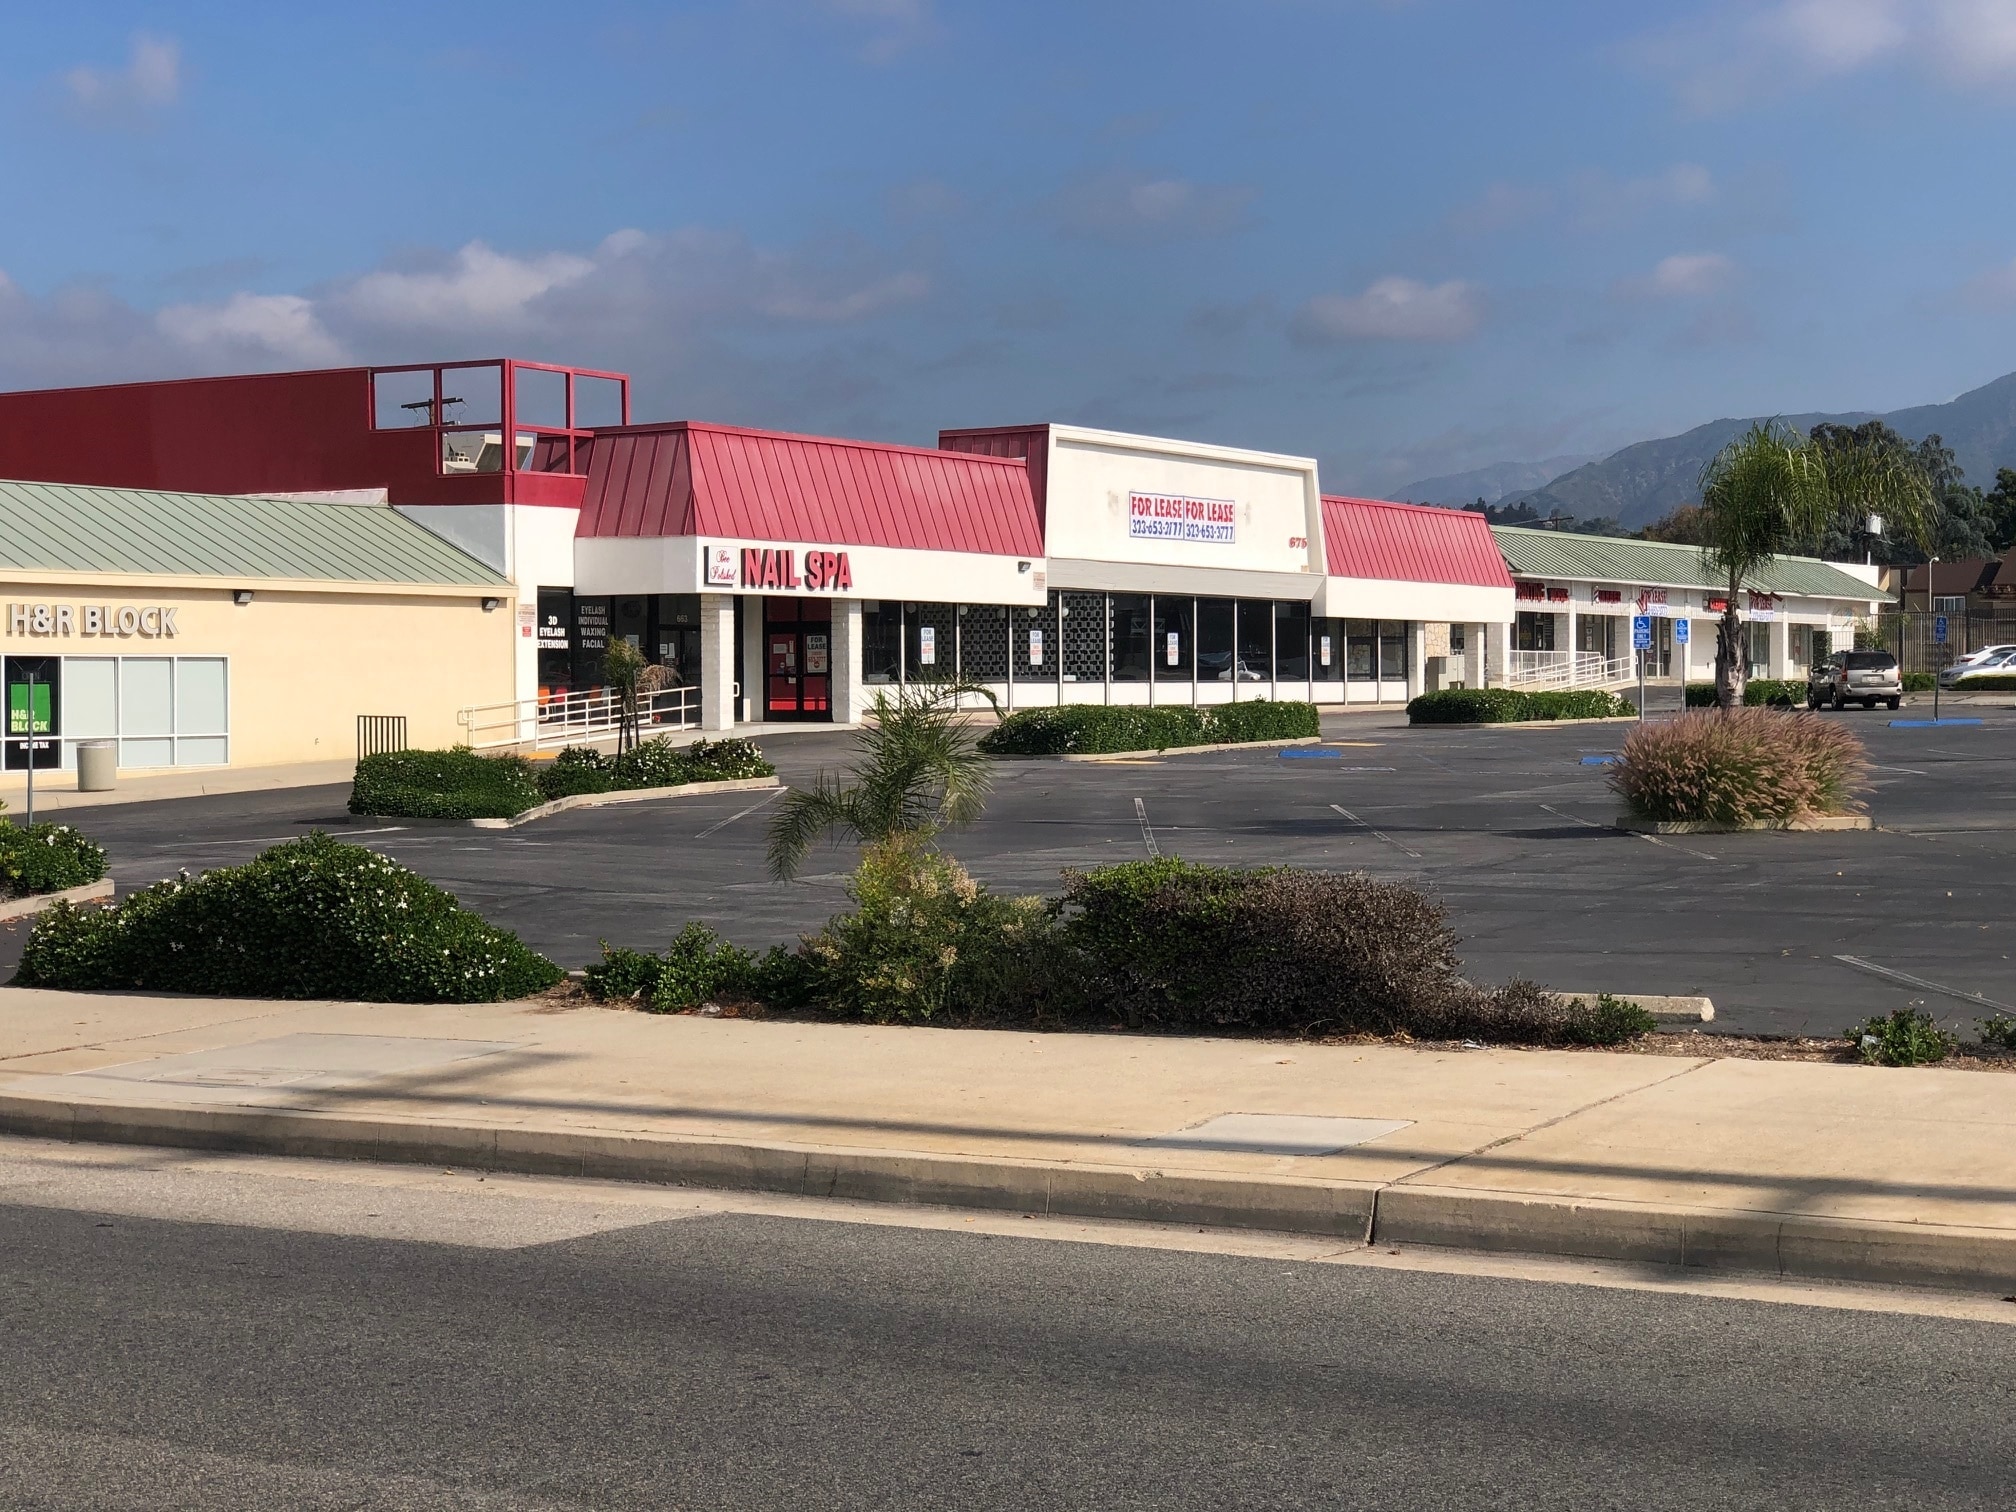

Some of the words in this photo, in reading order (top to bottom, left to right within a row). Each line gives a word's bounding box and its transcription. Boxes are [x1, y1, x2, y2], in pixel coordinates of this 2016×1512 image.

[1132, 496, 1152, 516] FOR
[1154, 498, 1182, 518] LEASE
[1186, 500, 1205, 520] FOR
[1207, 502, 1233, 523] LEASE
[1289, 537, 1307, 549] 675
[742, 548, 802, 588] NAIL
[806, 550, 853, 589] SPA
[581, 606, 606, 615] EYELASH
[9, 603, 75, 635] H&R
[83, 605, 180, 637] BLOCK
[548, 615, 558, 625] 3D
[578, 616, 609, 625] INDIVIDUAL
[539, 627, 565, 637] EYELASH
[580, 627, 606, 636] WAXING
[538, 640, 569, 649] EXTENSION
[582, 640, 605, 649] FACIAL
